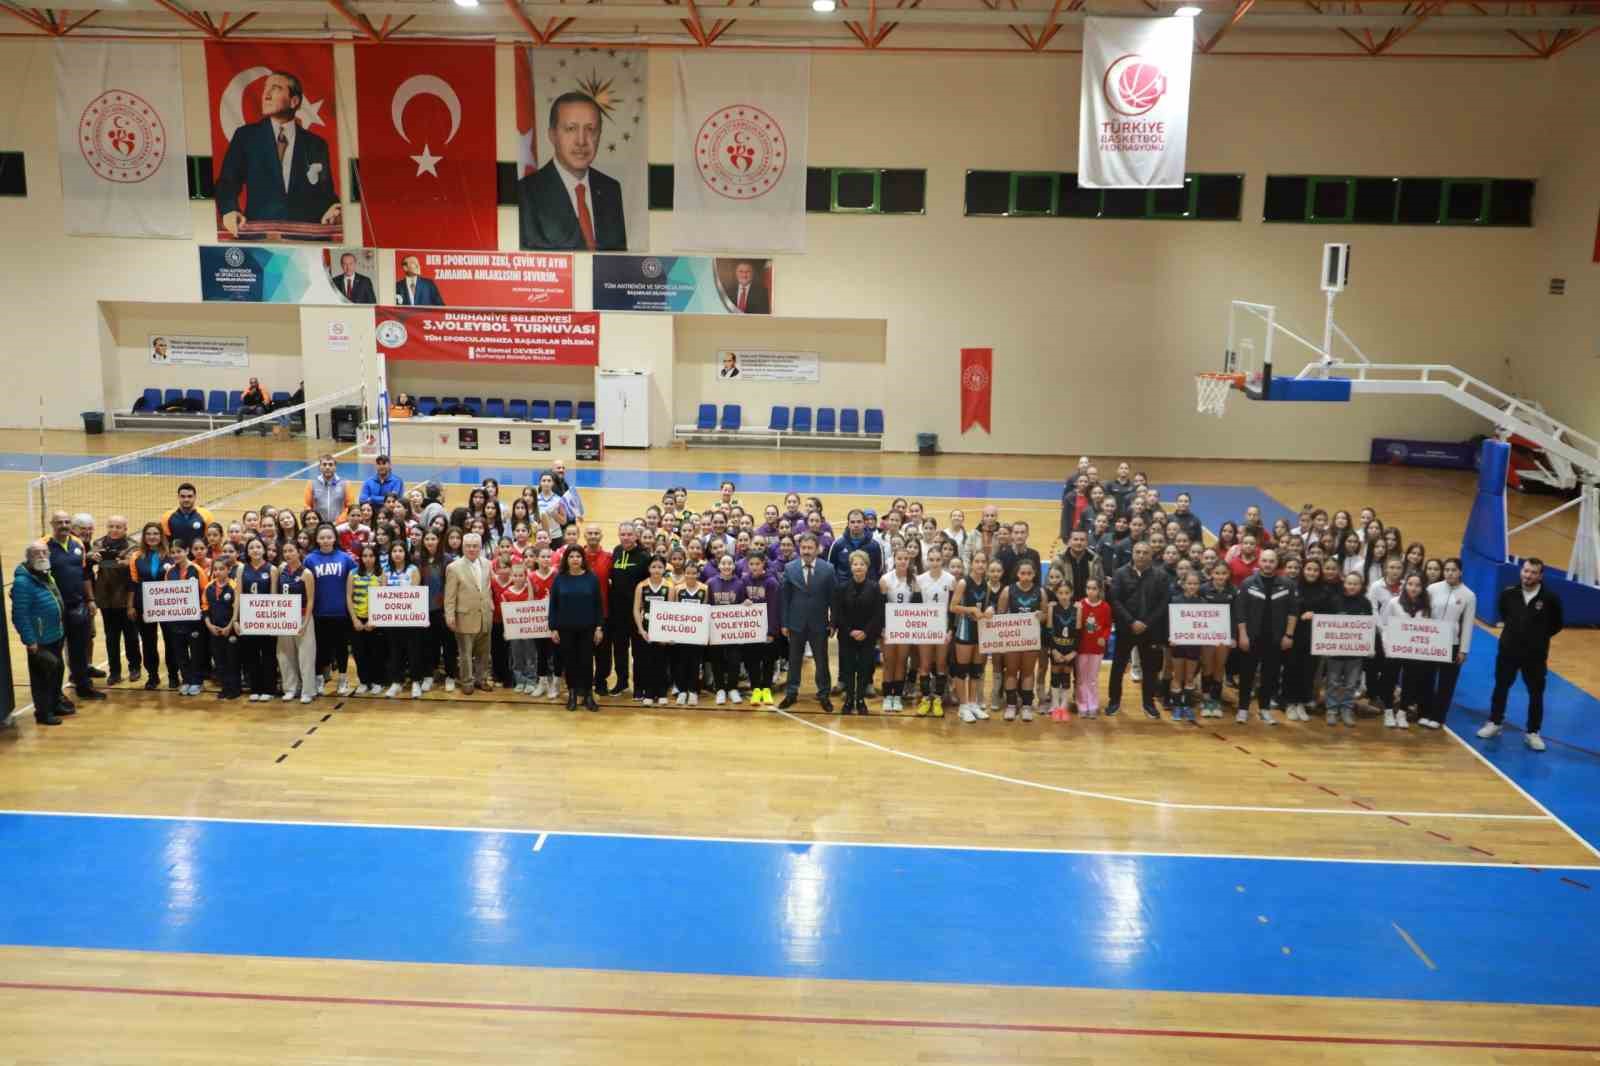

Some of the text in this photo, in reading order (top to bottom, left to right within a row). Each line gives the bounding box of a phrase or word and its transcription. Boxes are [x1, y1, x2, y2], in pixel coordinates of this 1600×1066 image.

[1101, 119, 1165, 133] TÜRKİYE
[1101, 135, 1165, 143] BASKETBOL
[1100, 144, 1164, 152] FEDERASYONU
[426, 255, 441, 265] BEN
[443, 255, 489, 266] SPORCUNUN
[537, 257, 547, 268] VE
[435, 269, 472, 280] ZAMANDA
[445, 312, 571, 324] BURHANİYE BELEDİYESİ
[423, 320, 595, 334] 3.VOLEYBOL TURNUVASI
[515, 337, 560, 346] BAŞARILAR
[150, 586, 192, 595] OSMANGAZİ
[154, 598, 188, 606] BELEDİYE
[896, 593, 903, 603] 9
[932, 593, 939, 602] 4
[249, 600, 275, 608] KUZEY
[385, 602, 412, 610] DORUK
[147, 608, 197, 617] SPOR KULÜBÜ
[256, 610, 286, 619] GELİŞİM
[394, 613, 426, 621] KULÜBÜ
[711, 609, 763, 620] ÇENGELKÖY
[894, 608, 939, 617] BURHANİYE
[656, 612, 703, 623] GÜRESPOR
[267, 621, 297, 629] KULÜBÜ
[715, 621, 760, 630] VOLEYBOL
[905, 619, 927, 628] ÖREN
[986, 618, 1032, 628] BURHANİYE
[1317, 620, 1372, 629] AYVALIKGÜCÜ
[661, 625, 696, 634] KULÜBÜ
[1401, 623, 1440, 634] İSTANBUL
[721, 631, 756, 640] KULÜBÜ
[912, 631, 943, 640] KULÜBÜ
[998, 629, 1020, 638] GÜCÜ
[1174, 631, 1227, 640] SPOR KULÜBÜ
[1325, 632, 1362, 640] BELEDİYE
[1006, 639, 1037, 648] KULÜBÜ
[1315, 643, 1371, 651] SPOR KULÜBÜ
[1392, 645, 1447, 656] SPOR KULÜBÜ
